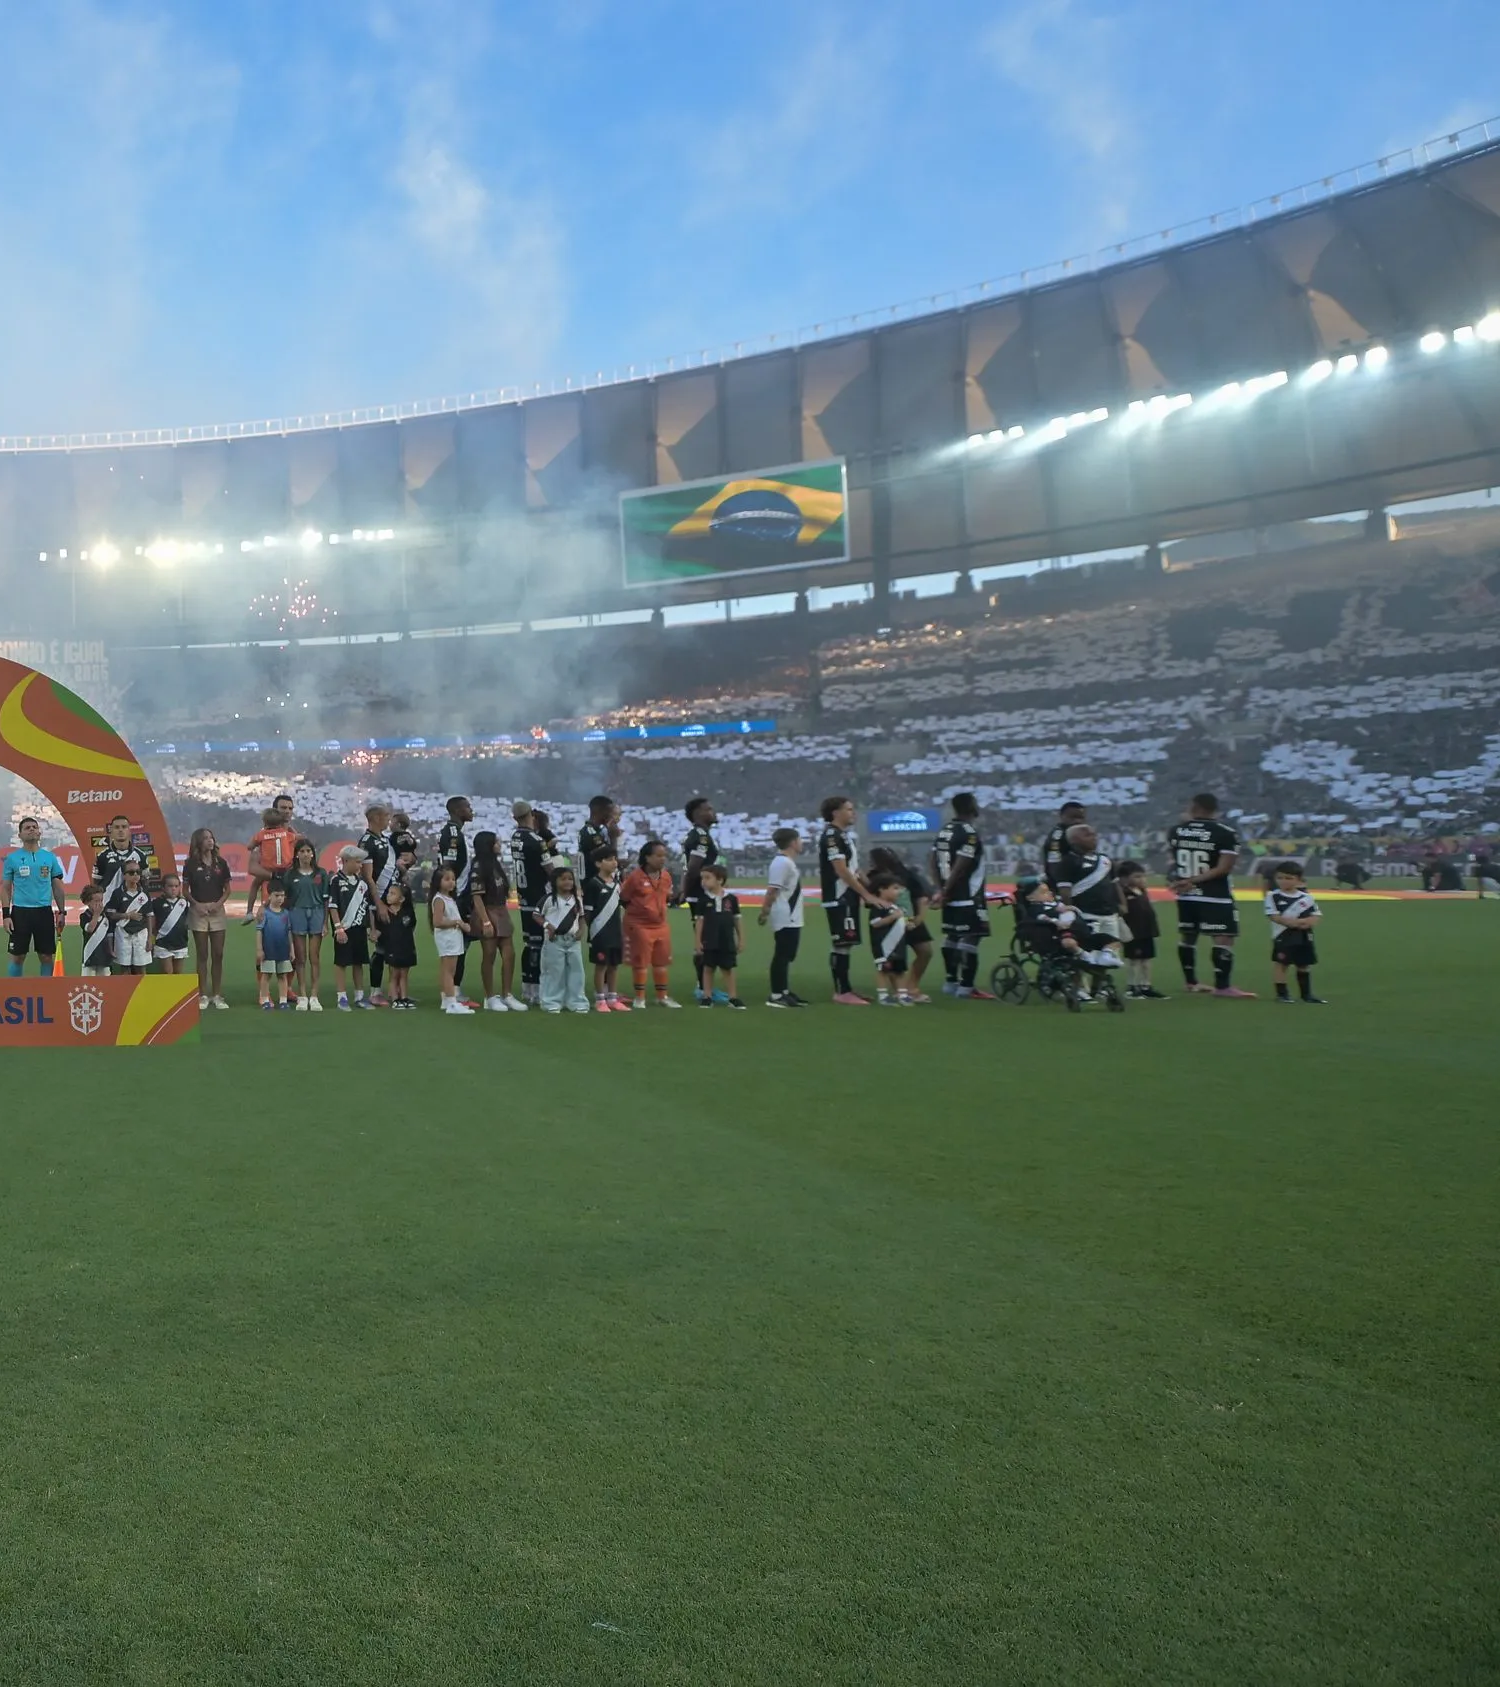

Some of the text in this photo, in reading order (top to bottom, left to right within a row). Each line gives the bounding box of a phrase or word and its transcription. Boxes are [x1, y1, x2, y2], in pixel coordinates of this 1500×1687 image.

[67, 789, 123, 804] Betano
[275, 838, 282, 865] 1
[1176, 849, 1211, 878] 96
